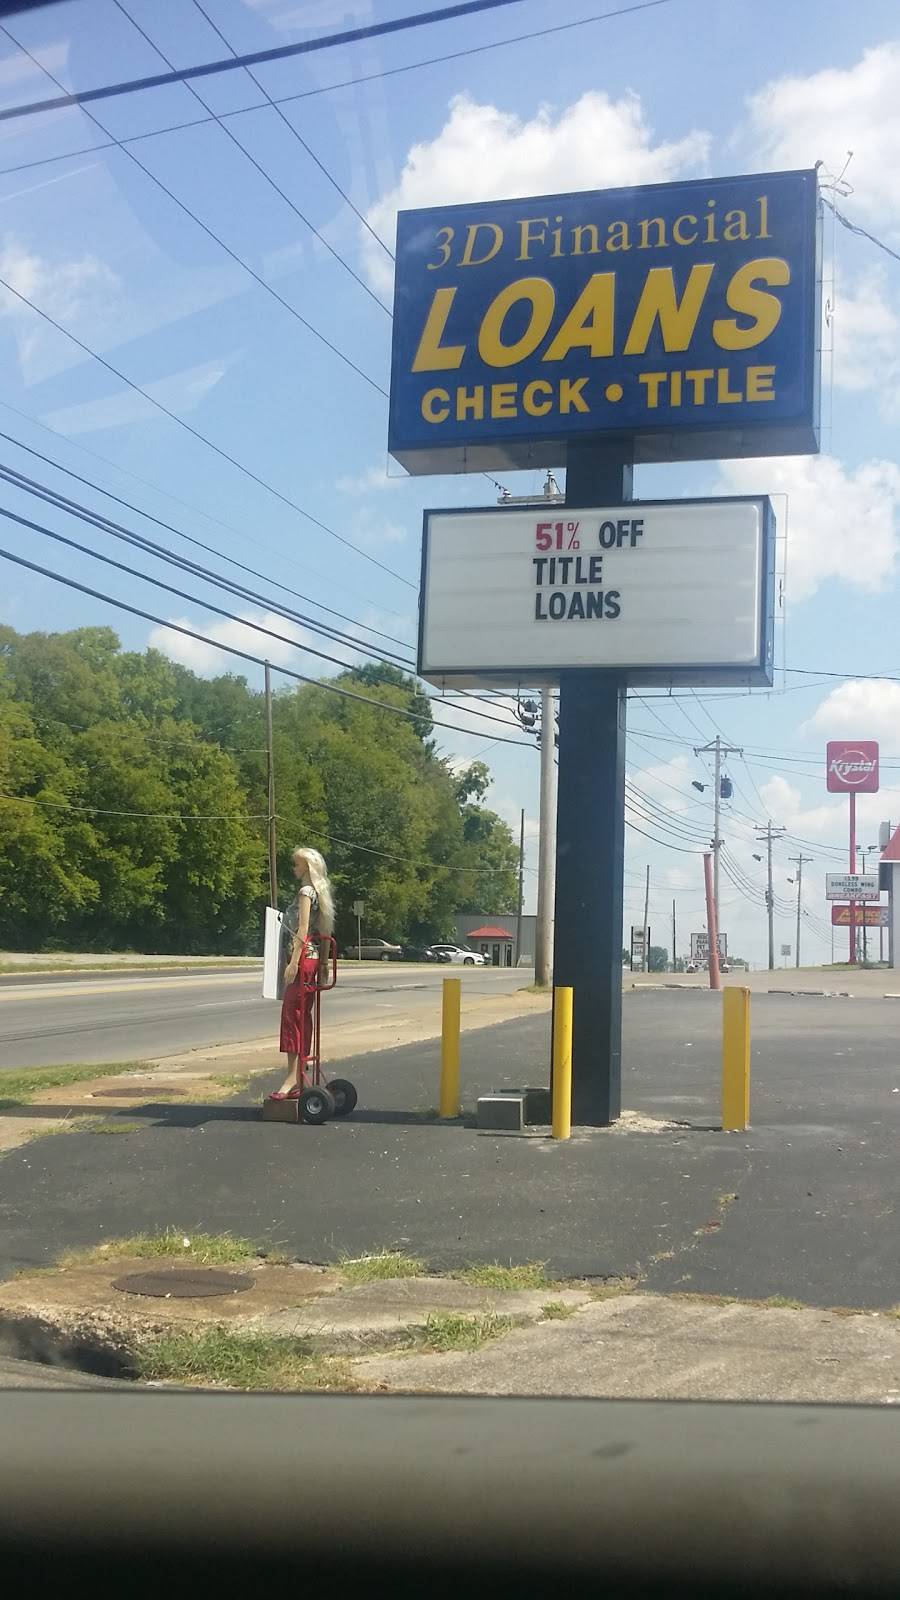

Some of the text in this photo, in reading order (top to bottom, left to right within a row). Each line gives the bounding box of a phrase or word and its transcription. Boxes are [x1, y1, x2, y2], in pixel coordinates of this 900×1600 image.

[516, 196, 773, 261] Financial
[411, 257, 790, 373] LOANS
[421, 366, 776, 424] CHECK TITLE
[535, 519, 644, 551] 51% OFF
[532, 556, 603, 586] TITLE
[535, 590, 621, 620] LOANS
[829, 759, 877, 776] Krystal
